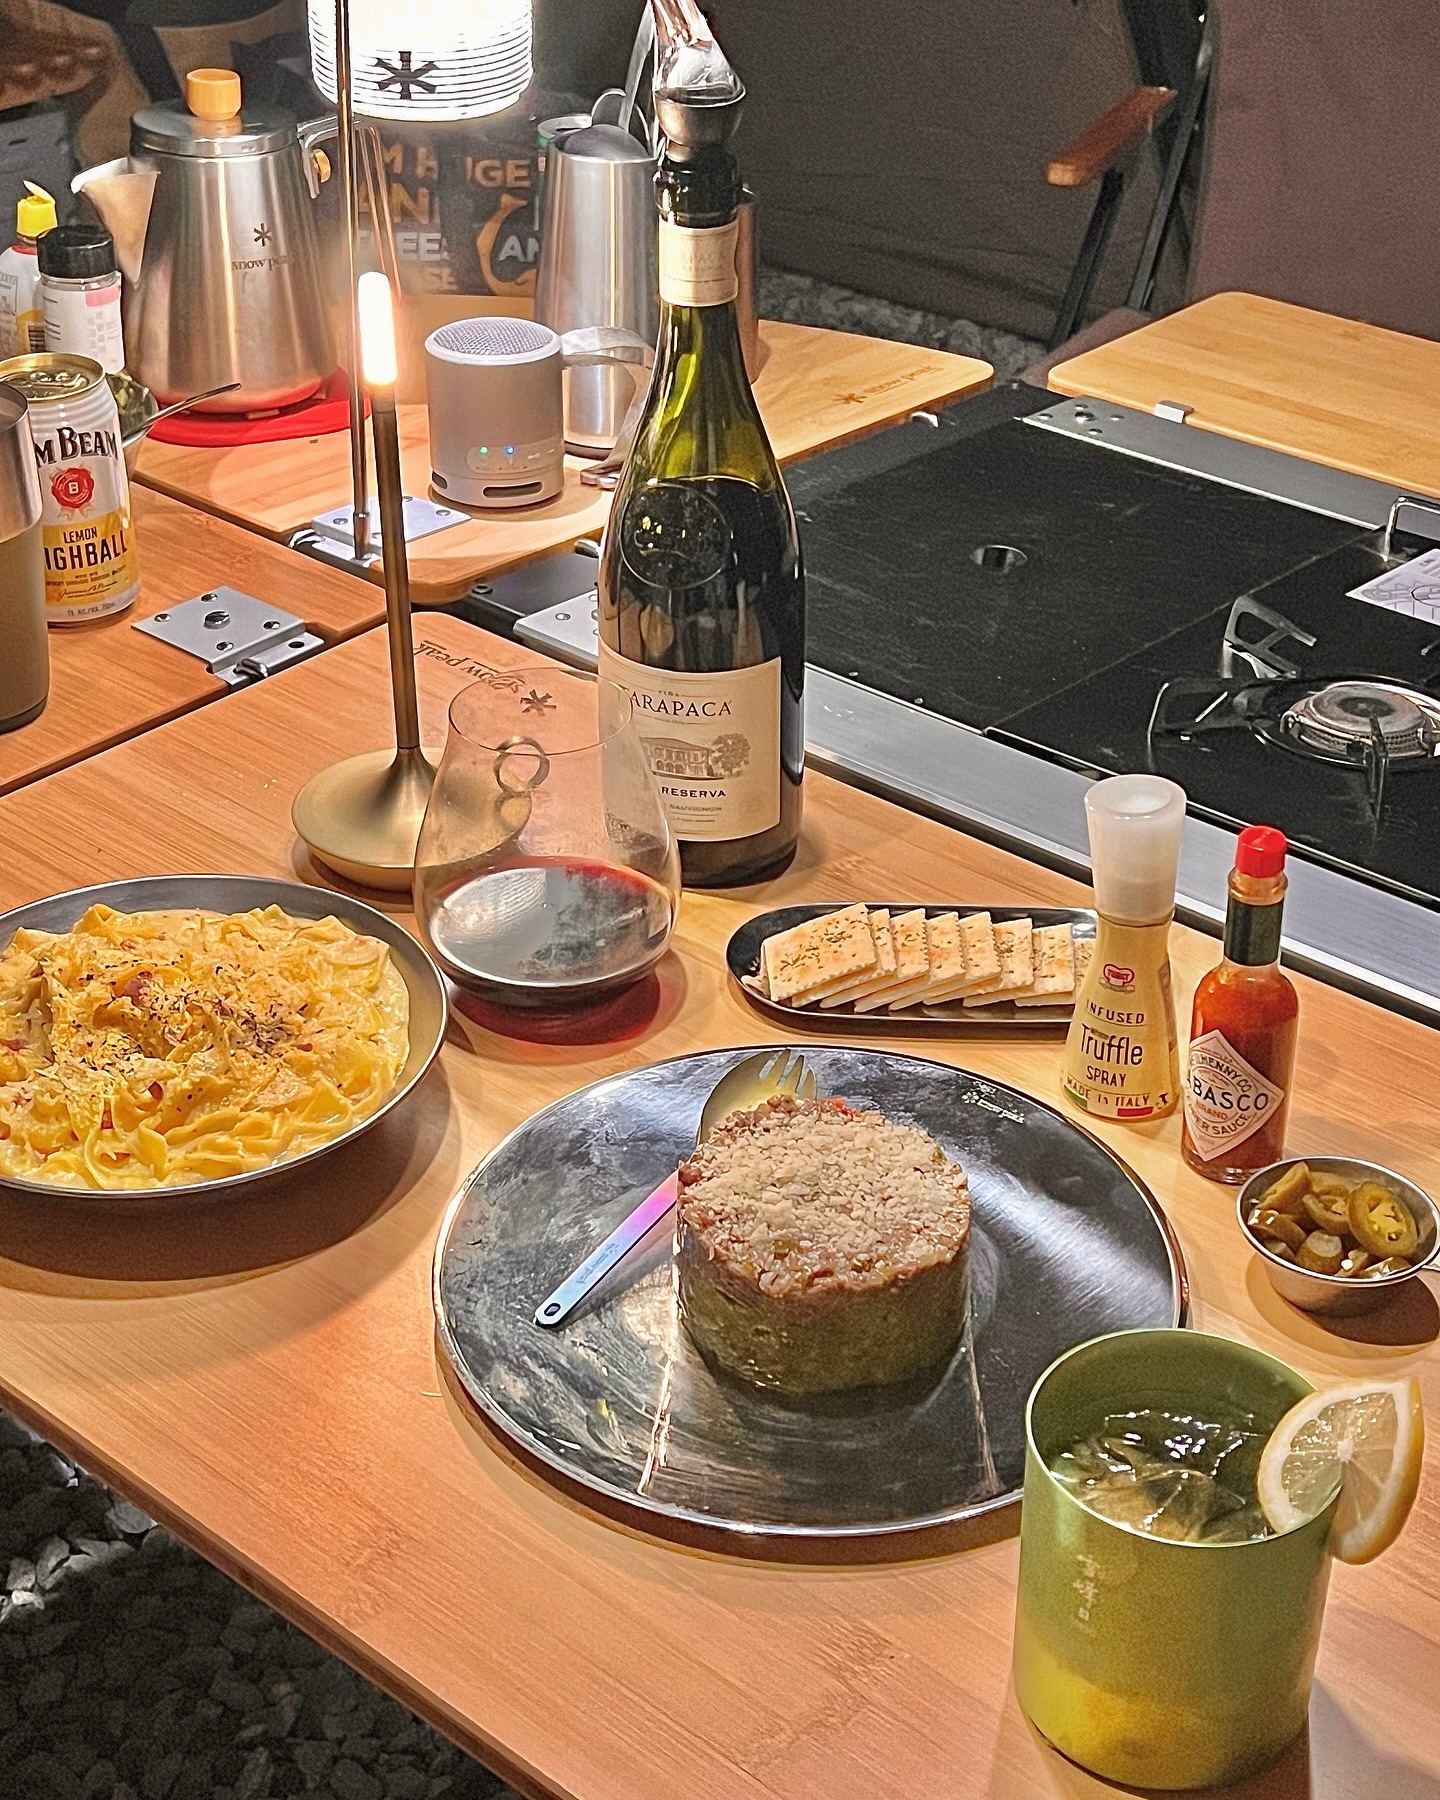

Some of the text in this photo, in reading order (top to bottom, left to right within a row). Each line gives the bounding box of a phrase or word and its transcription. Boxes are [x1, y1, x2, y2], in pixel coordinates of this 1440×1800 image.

[33, 439, 57, 468] M
[68, 481, 80, 495] B
[63, 526, 98, 544] LEMON
[44, 530, 128, 571] IGHBALL
[630, 691, 733, 717] ARAPACÁ
[661, 786, 727, 798] RESERVA
[1086, 998, 1146, 1024] INFUSED
[1081, 1023, 1144, 1066] Truffle
[1086, 1065, 1127, 1088] SPRAY
[1191, 1053, 1242, 1079] HENNY
[1066, 1075, 1091, 1099] MADE
[1115, 1094, 1150, 1107] ITALY
[1188, 1074, 1269, 1112] BASCO
[1212, 1113, 1252, 1135] SAUCE
